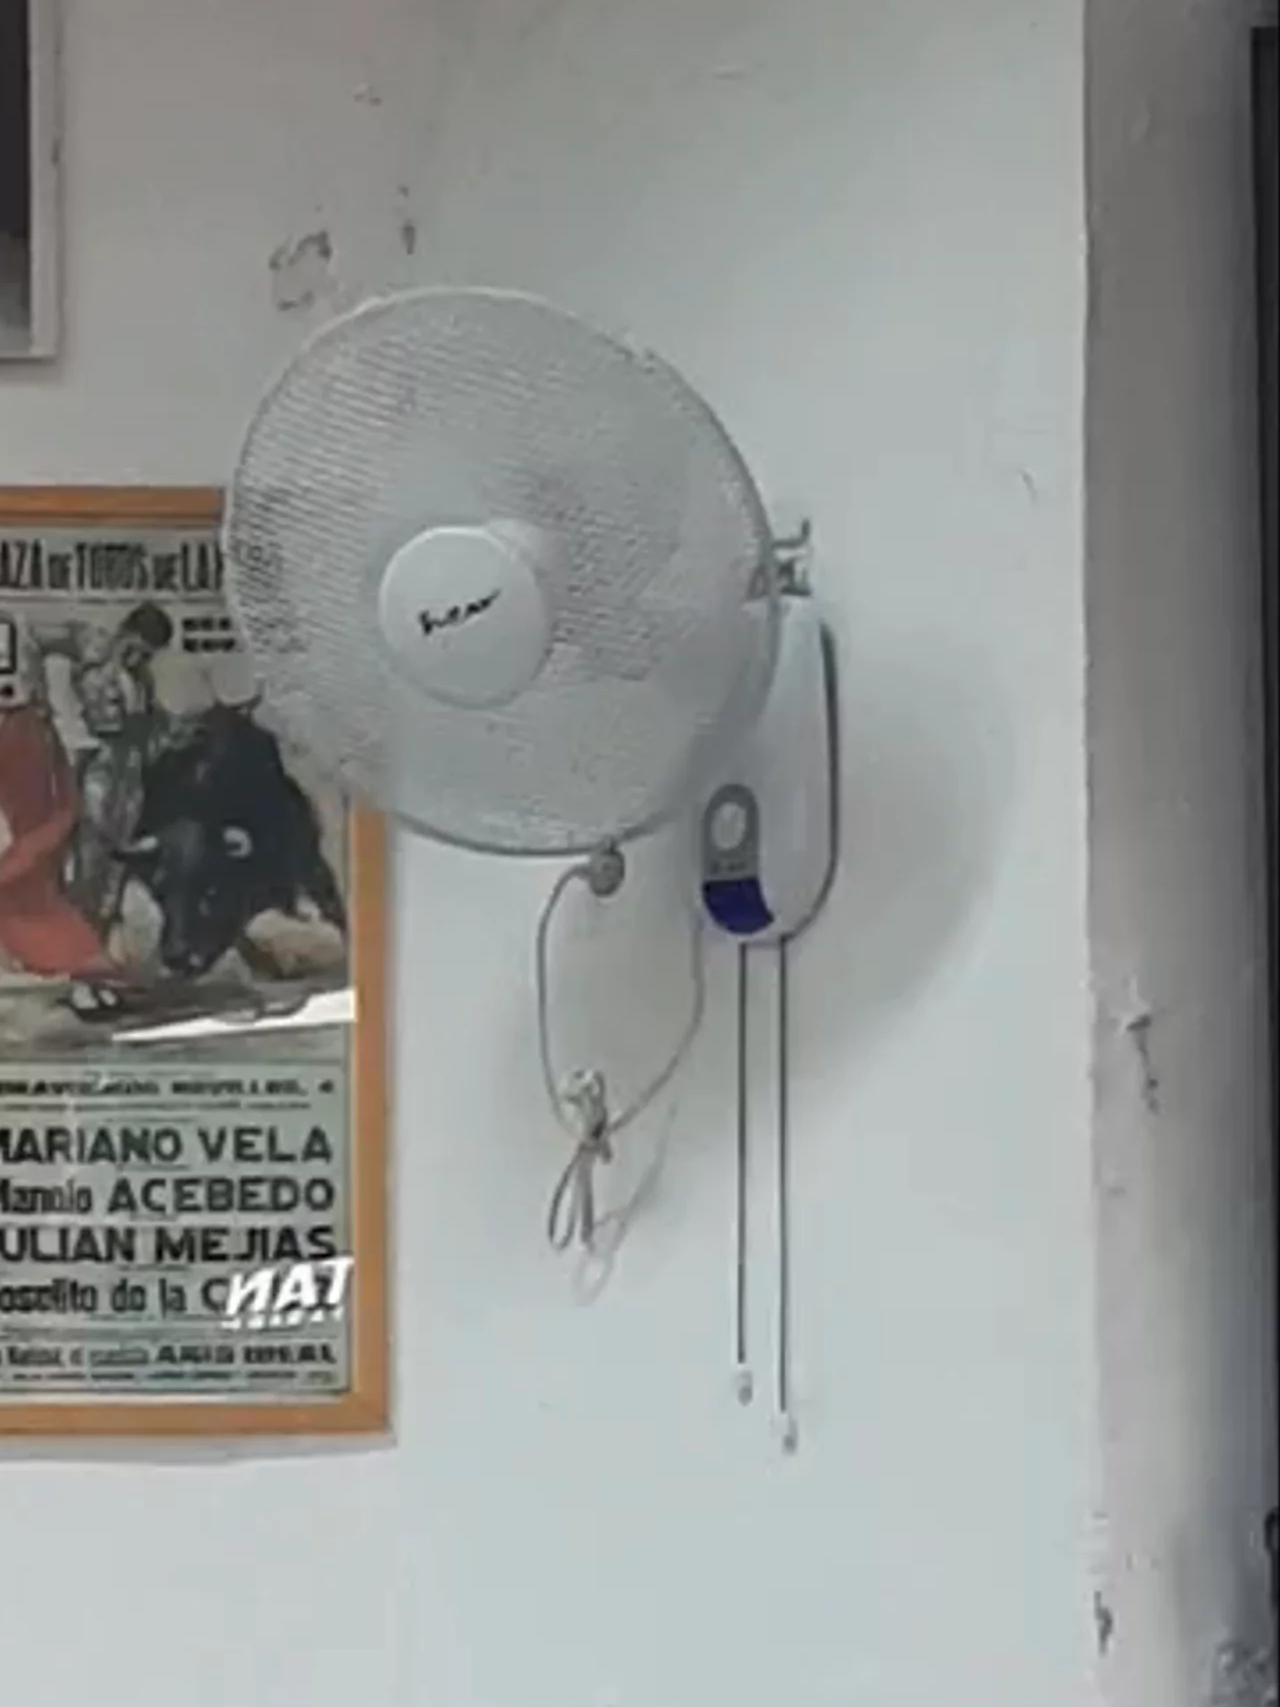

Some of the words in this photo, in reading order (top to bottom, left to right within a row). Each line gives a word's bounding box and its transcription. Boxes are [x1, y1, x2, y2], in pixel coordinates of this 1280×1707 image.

[76, 542, 149, 590] TOROS
[198, 1126, 333, 1163] VELA
[107, 1177, 335, 1214] ACEBEDO
[154, 1225, 337, 1262] MEJIAS
[159, 1277, 188, 1316] la
